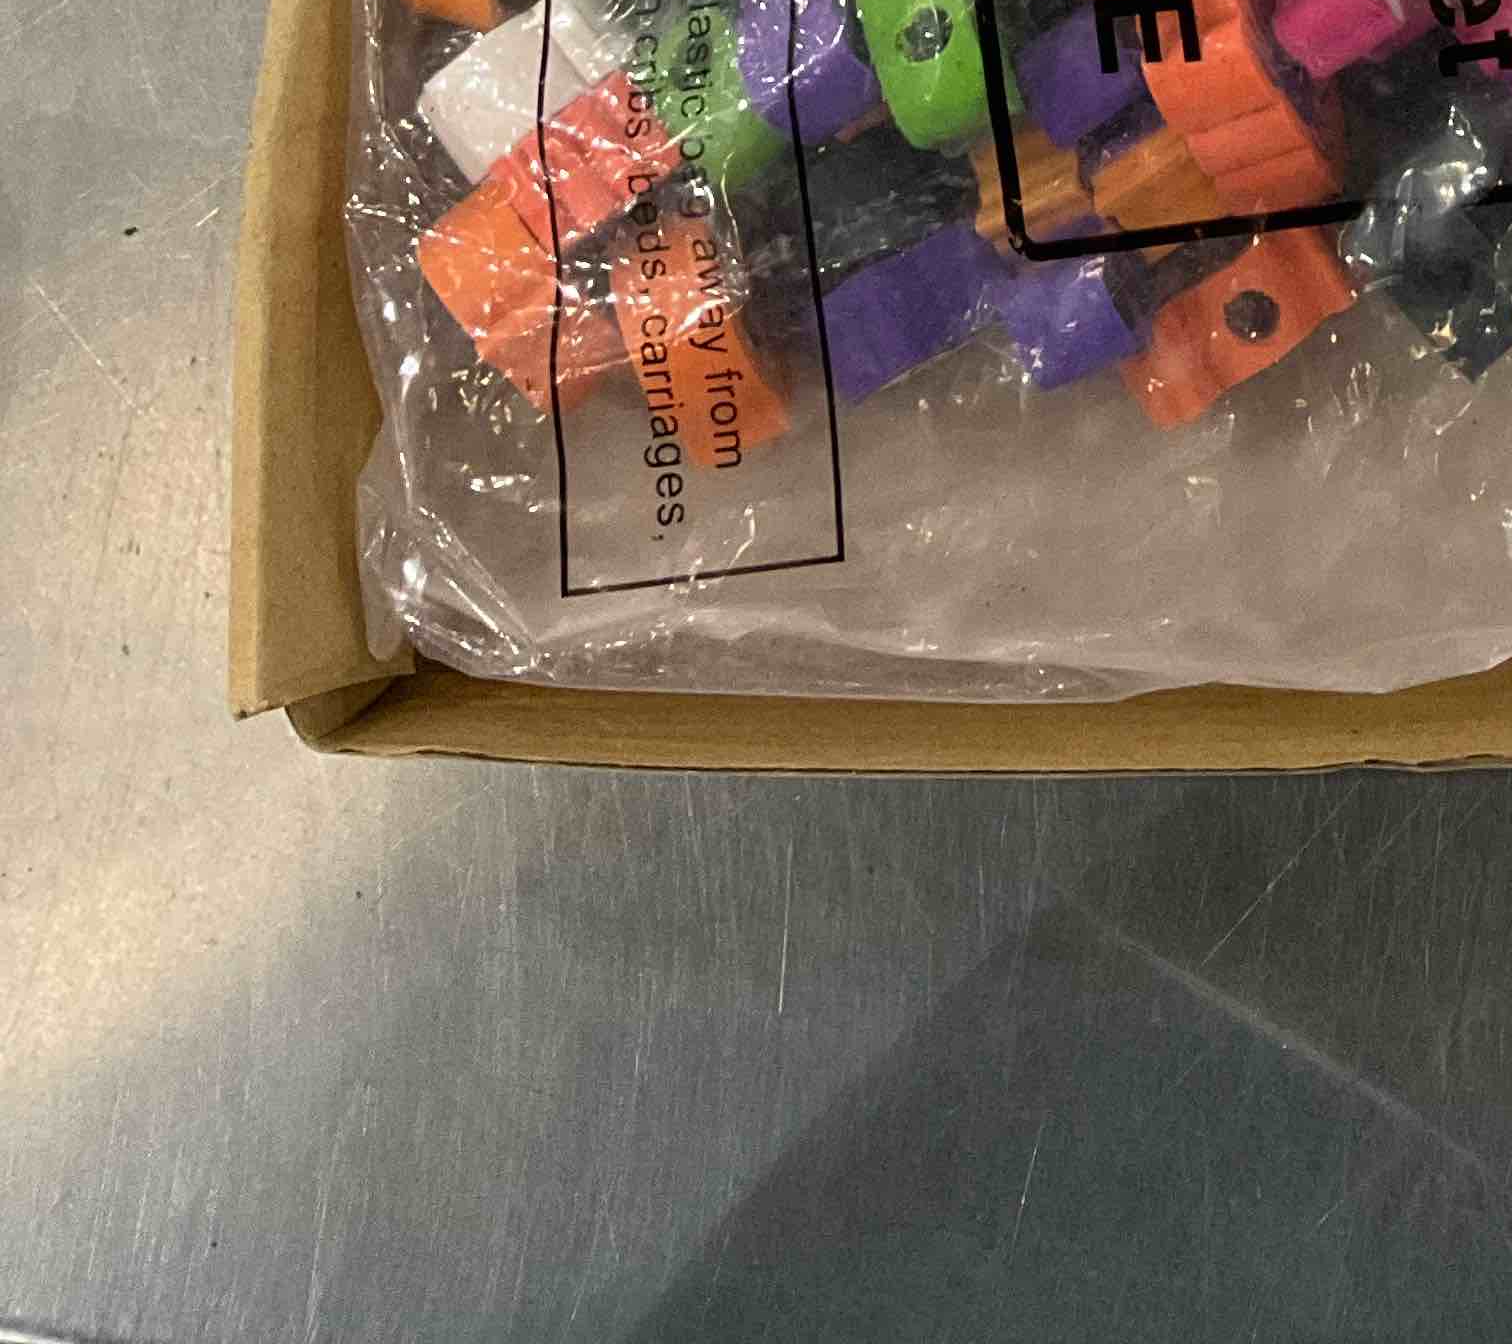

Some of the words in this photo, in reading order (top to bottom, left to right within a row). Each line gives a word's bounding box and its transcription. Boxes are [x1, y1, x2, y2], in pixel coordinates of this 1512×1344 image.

[689, 238, 730, 353] away
[641, 314, 687, 543] carriages,
[704, 368, 745, 470] from
